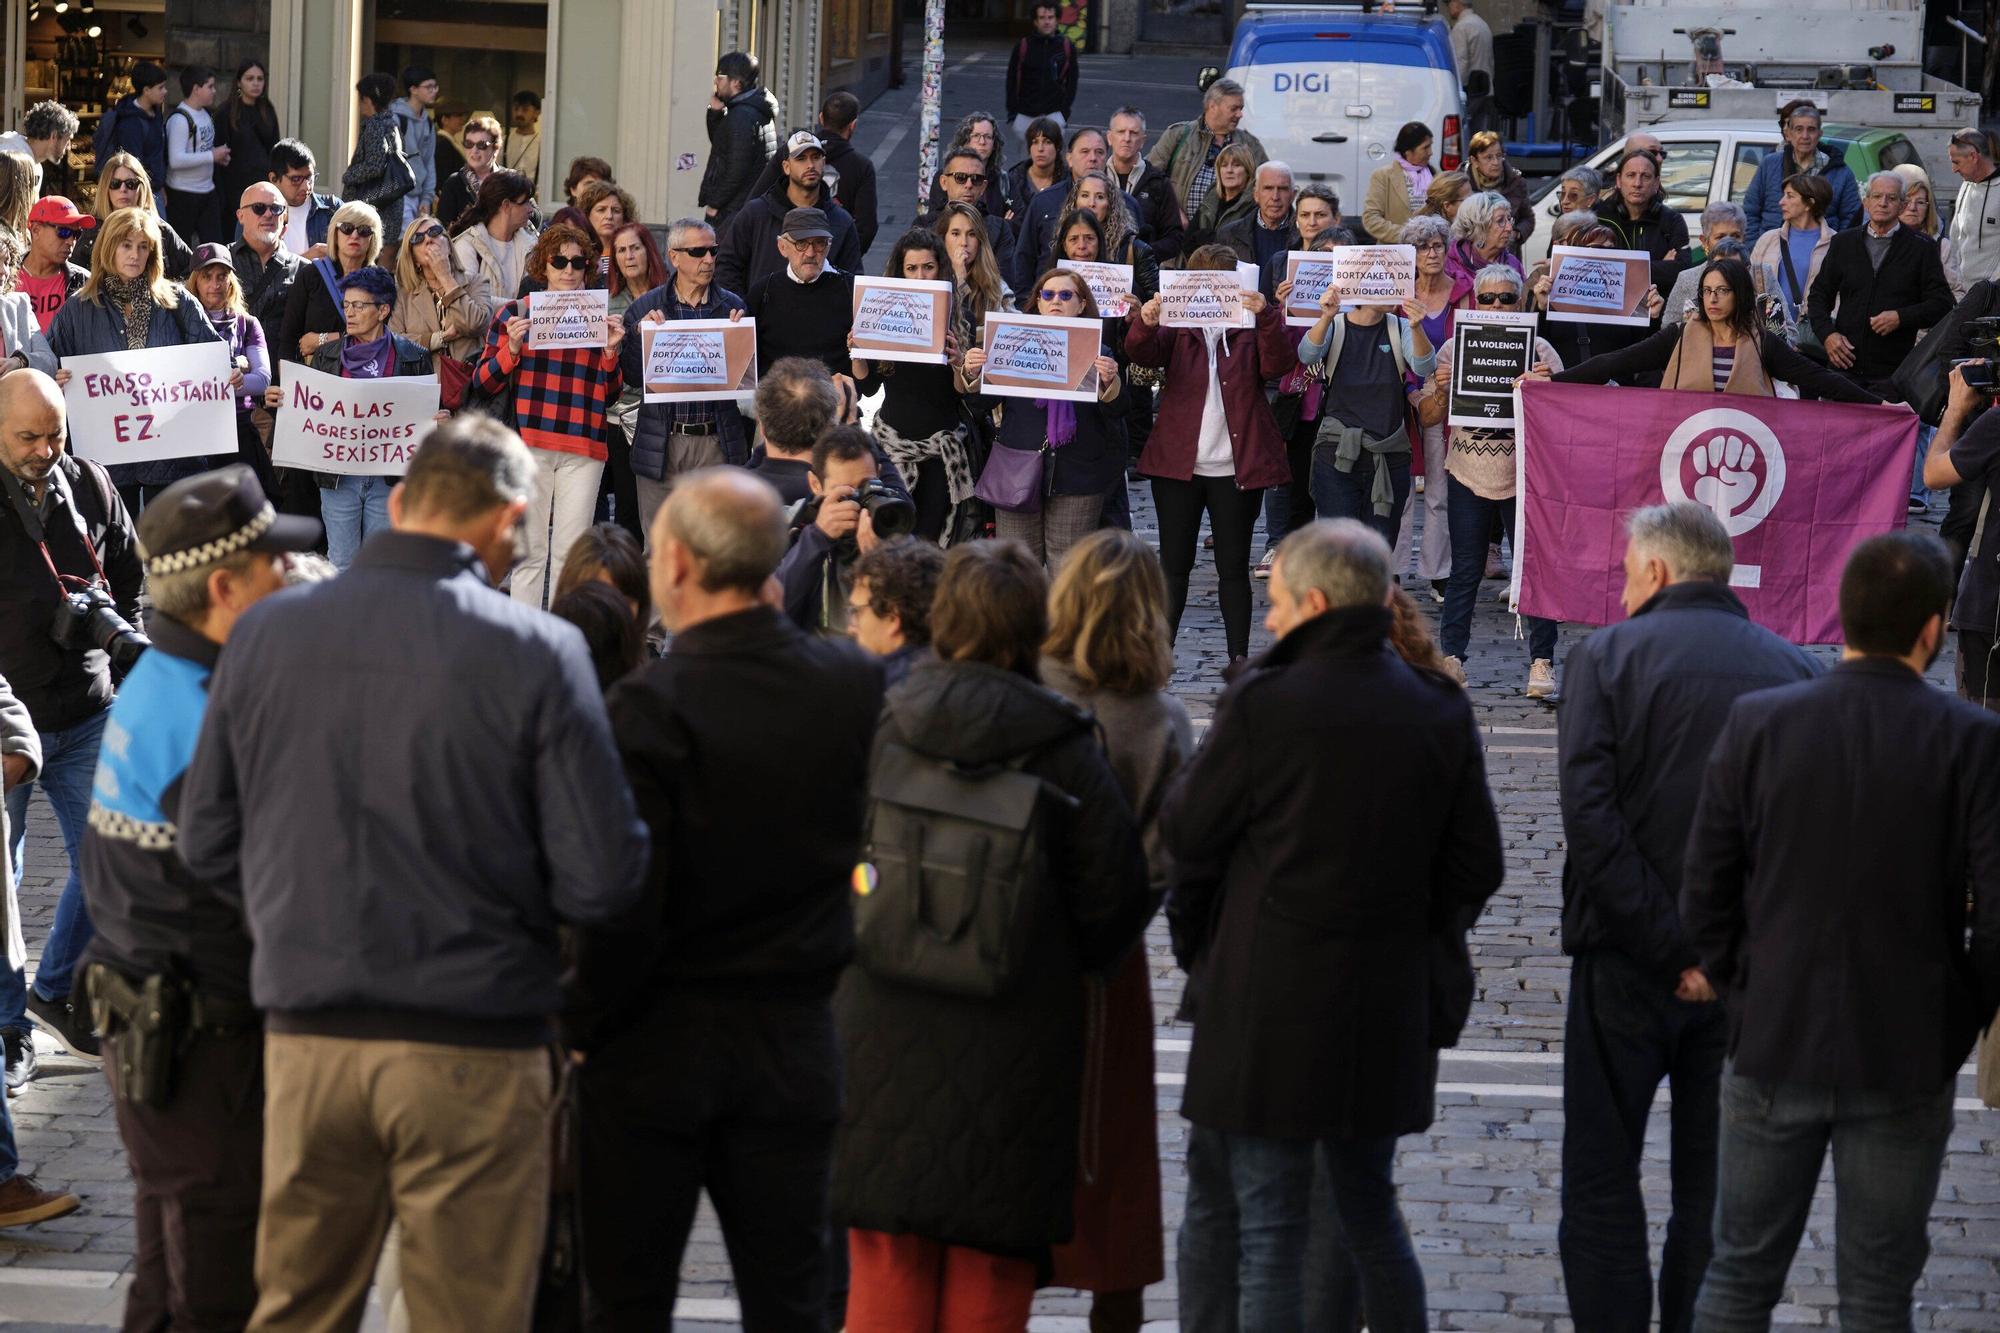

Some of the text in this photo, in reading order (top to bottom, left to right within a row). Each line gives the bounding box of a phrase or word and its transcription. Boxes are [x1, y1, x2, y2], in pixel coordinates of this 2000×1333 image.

[1275, 73, 1329, 92] DIGI
[1336, 271, 1395, 280] BORTXAKETA
[1559, 274, 1607, 286] BORTXAKETA
[1296, 279, 1332, 288] BORTXAK
[1353, 286, 1405, 296] VIOLACIÓN!
[1558, 286, 1567, 294] ES
[1569, 288, 1615, 300] VIOLACIÓN!
[1162, 295, 1222, 303] BORTXAKETA
[861, 307, 914, 319] BORTXAKETA
[1180, 309, 1232, 318] VIOLACIÓN!
[533, 315, 588, 325] BORTXAKETA
[861, 321, 870, 329] ES
[872, 323, 922, 335] VIOLACIÓN!
[537, 329, 598, 340] ES VIOLACIÓN!
[994, 343, 1048, 355] BORTXAKETA
[1468, 340, 1524, 350] LA VIOLENCIA
[652, 351, 707, 359] BORTXAKETA
[994, 357, 1004, 365] ES
[1006, 359, 1057, 372] VIOLACIÓN!
[1472, 358, 1517, 367] MACHISTA
[654, 364, 717, 374] ES VIOLACIÓN!
[1467, 375, 1484, 383] QUE
[85, 373, 152, 398] ERASO
[331, 400, 345, 417] A
[353, 402, 394, 418] LAS
[114, 414, 160, 443] EZ.
